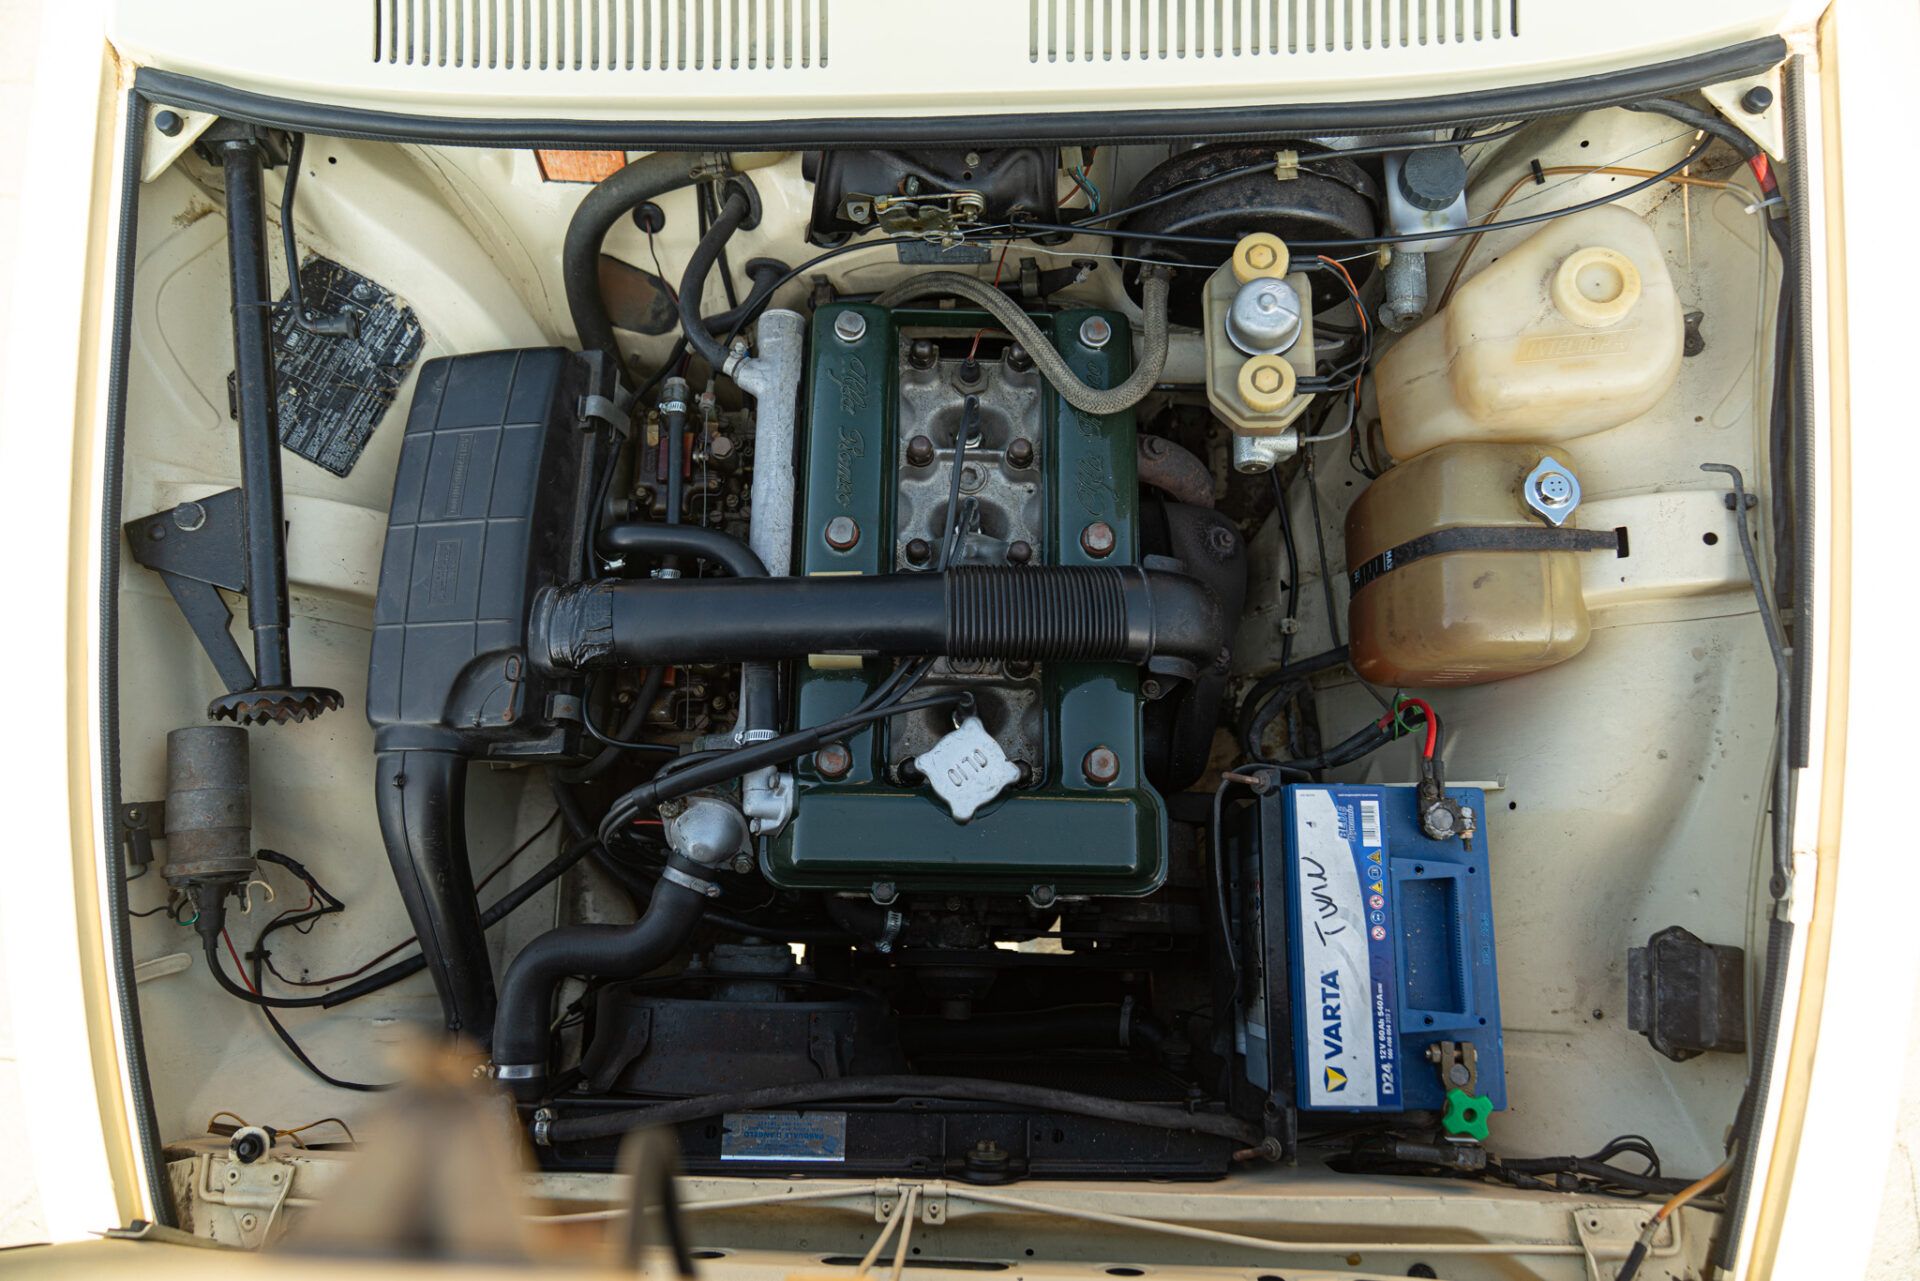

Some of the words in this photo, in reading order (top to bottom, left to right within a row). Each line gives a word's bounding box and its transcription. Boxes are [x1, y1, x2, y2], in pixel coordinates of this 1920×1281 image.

[1385, 550, 1393, 571] MAX
[1337, 805, 1348, 839] BLUE
[1321, 970, 1343, 1060] VARTA
[1378, 1018, 1386, 1041] 60Ah
[1379, 1042, 1387, 1060] 12V
[1381, 1063, 1395, 1095] D24
